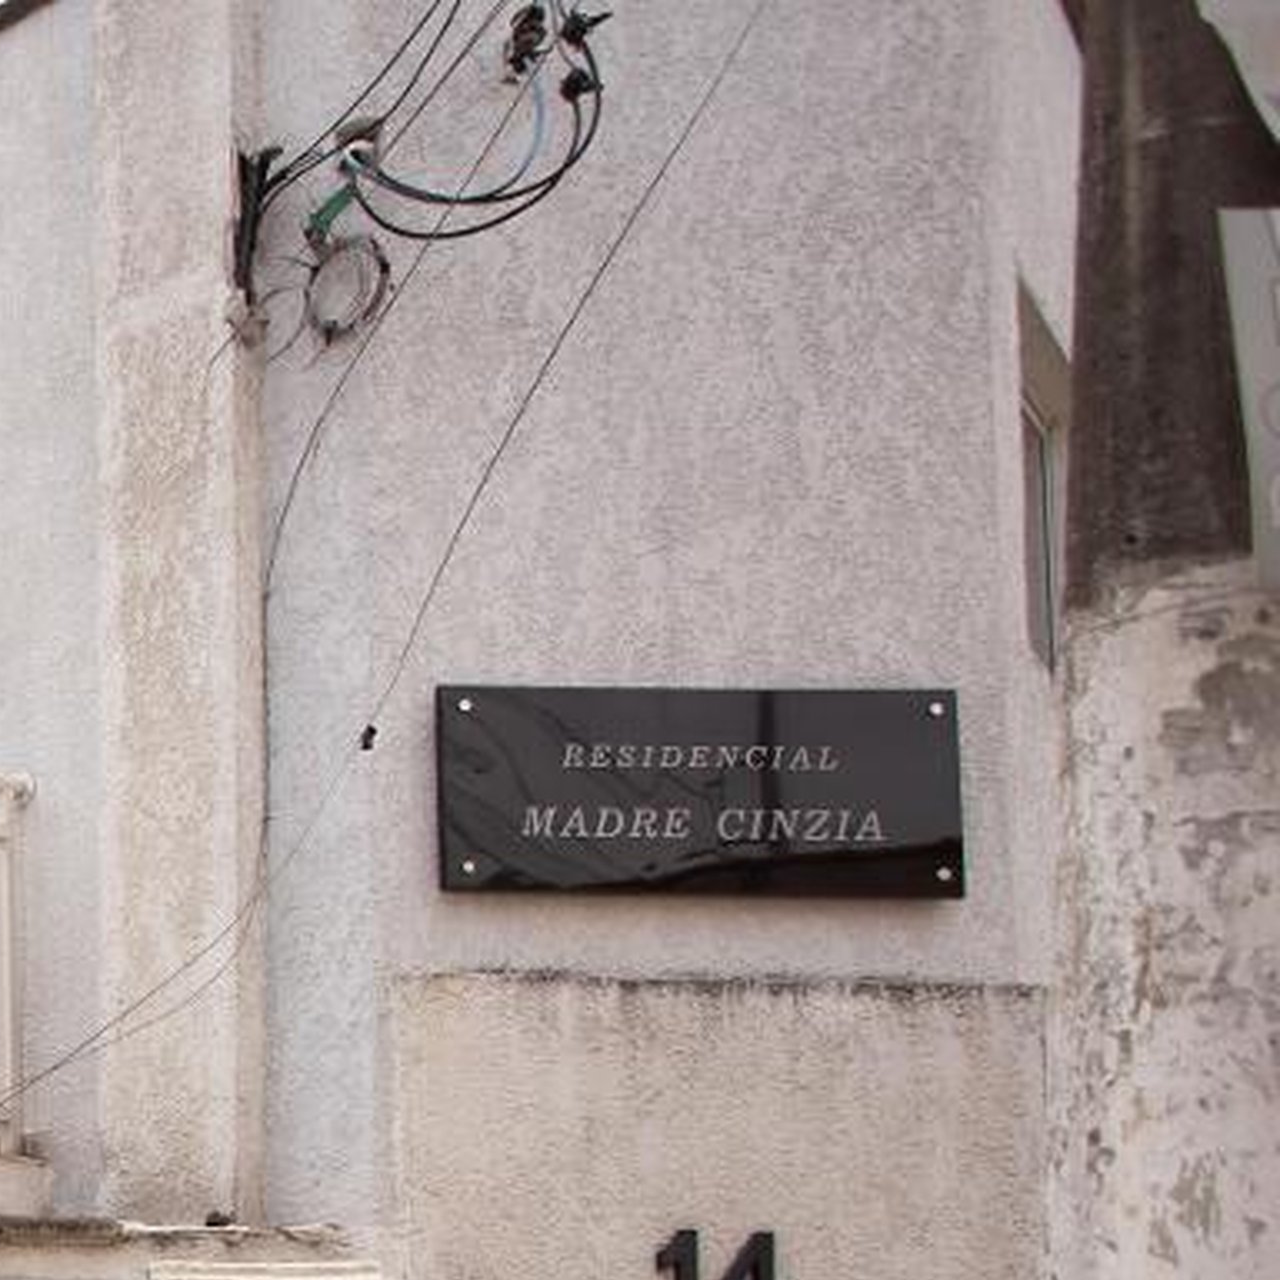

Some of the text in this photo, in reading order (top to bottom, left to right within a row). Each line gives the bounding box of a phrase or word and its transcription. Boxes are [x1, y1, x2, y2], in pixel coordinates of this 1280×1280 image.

[561, 743, 840, 772] RESIDENCIAL
[521, 806, 890, 843] MADRE CINZIA
